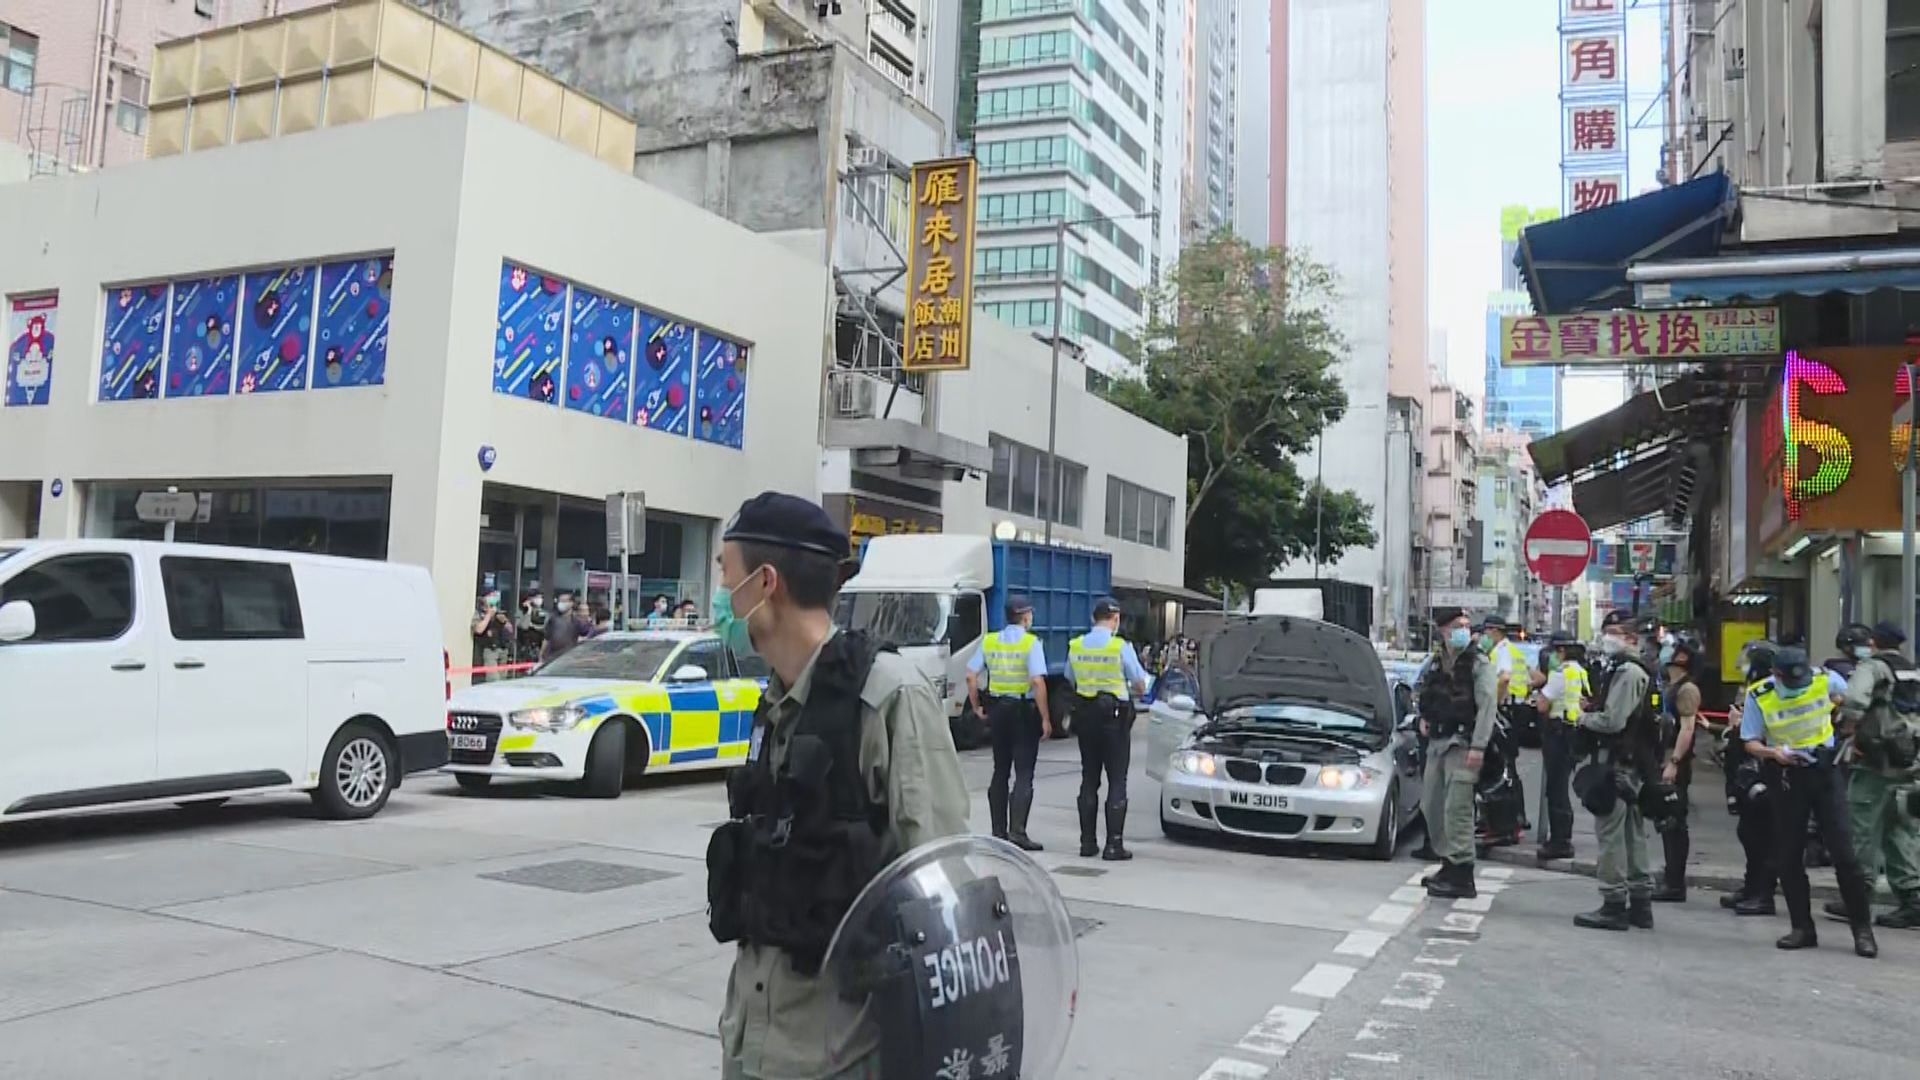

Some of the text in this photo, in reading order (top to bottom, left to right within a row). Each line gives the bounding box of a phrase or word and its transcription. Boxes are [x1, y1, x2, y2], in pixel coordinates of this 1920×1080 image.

[1571, 0, 1618, 212] 角購物
[910, 300, 936, 360] 飯店
[938, 298, 961, 357] 潮州
[1510, 312, 1700, 360] 金寶找換
[1230, 790, 1288, 809] WM 3015
[924, 930, 1009, 1008] POLICE
